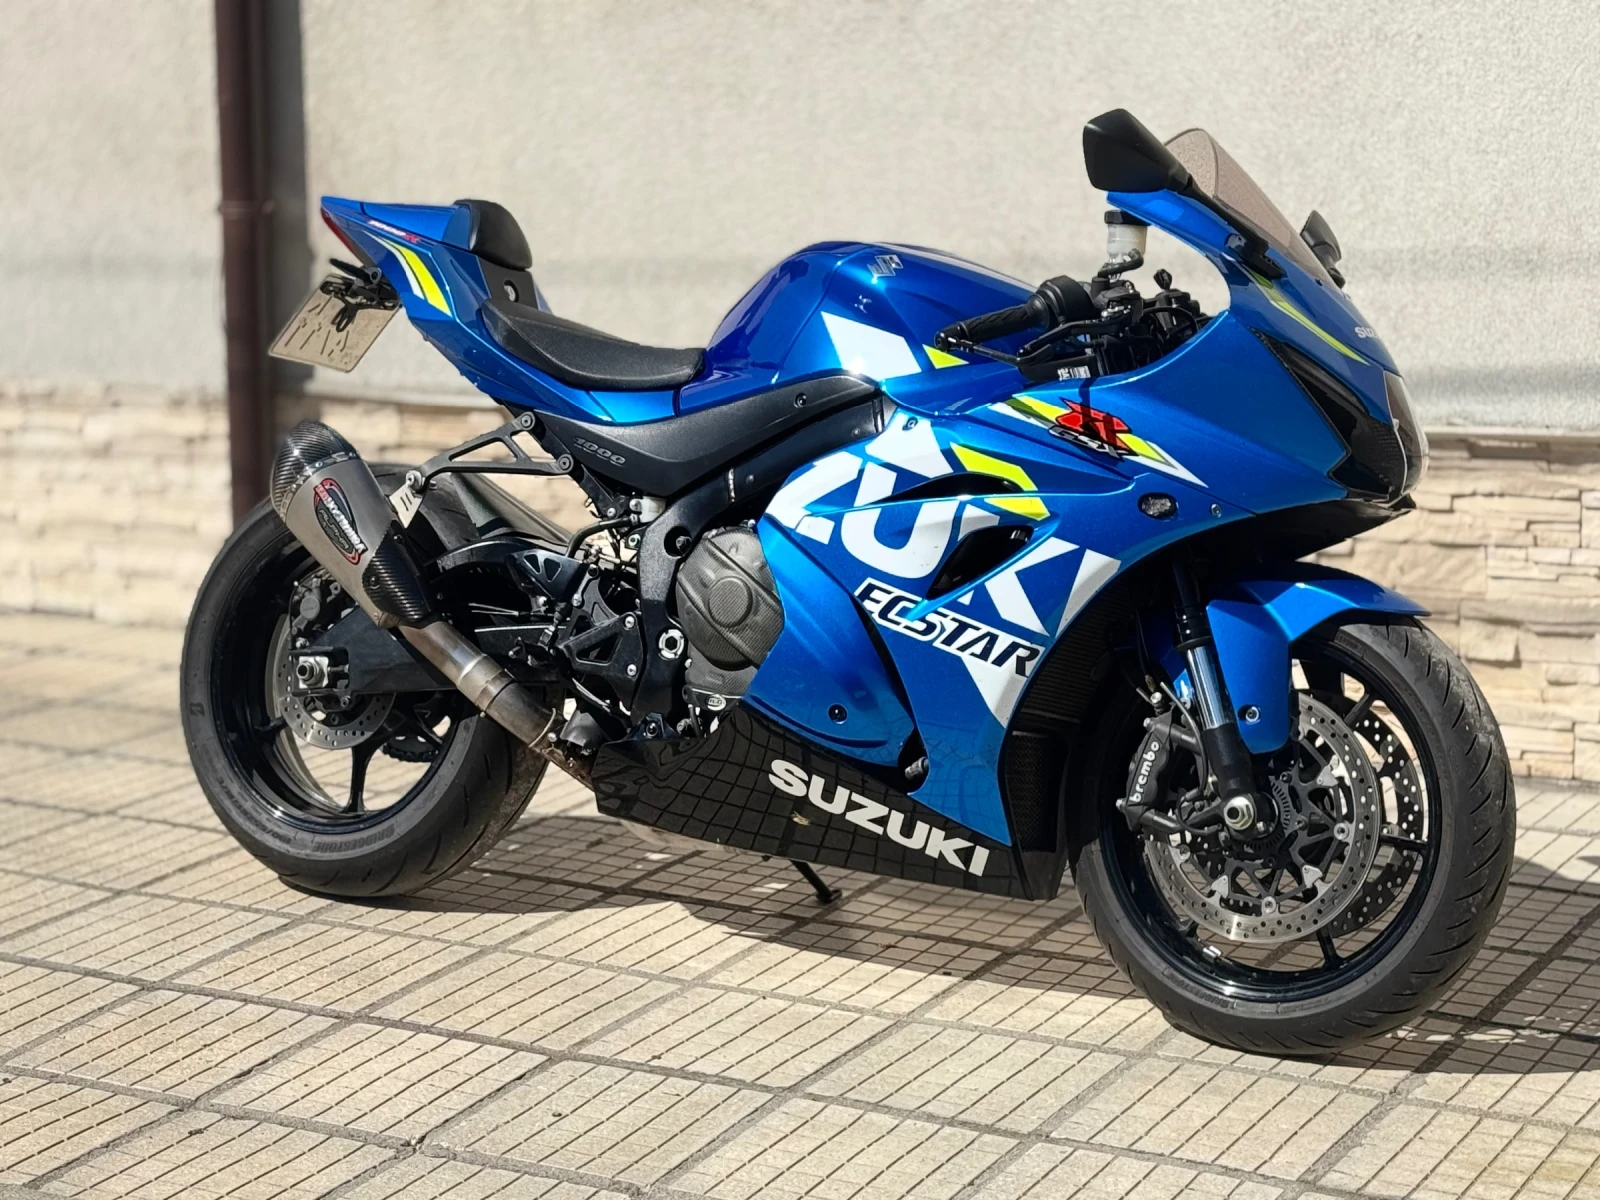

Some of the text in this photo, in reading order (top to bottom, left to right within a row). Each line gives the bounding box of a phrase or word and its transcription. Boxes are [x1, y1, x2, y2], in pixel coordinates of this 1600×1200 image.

[573, 436, 626, 467] 1000
[856, 580, 1043, 679] ECSTAR
[1129, 741, 1159, 803] brembo
[768, 759, 990, 877] SUZUKI
